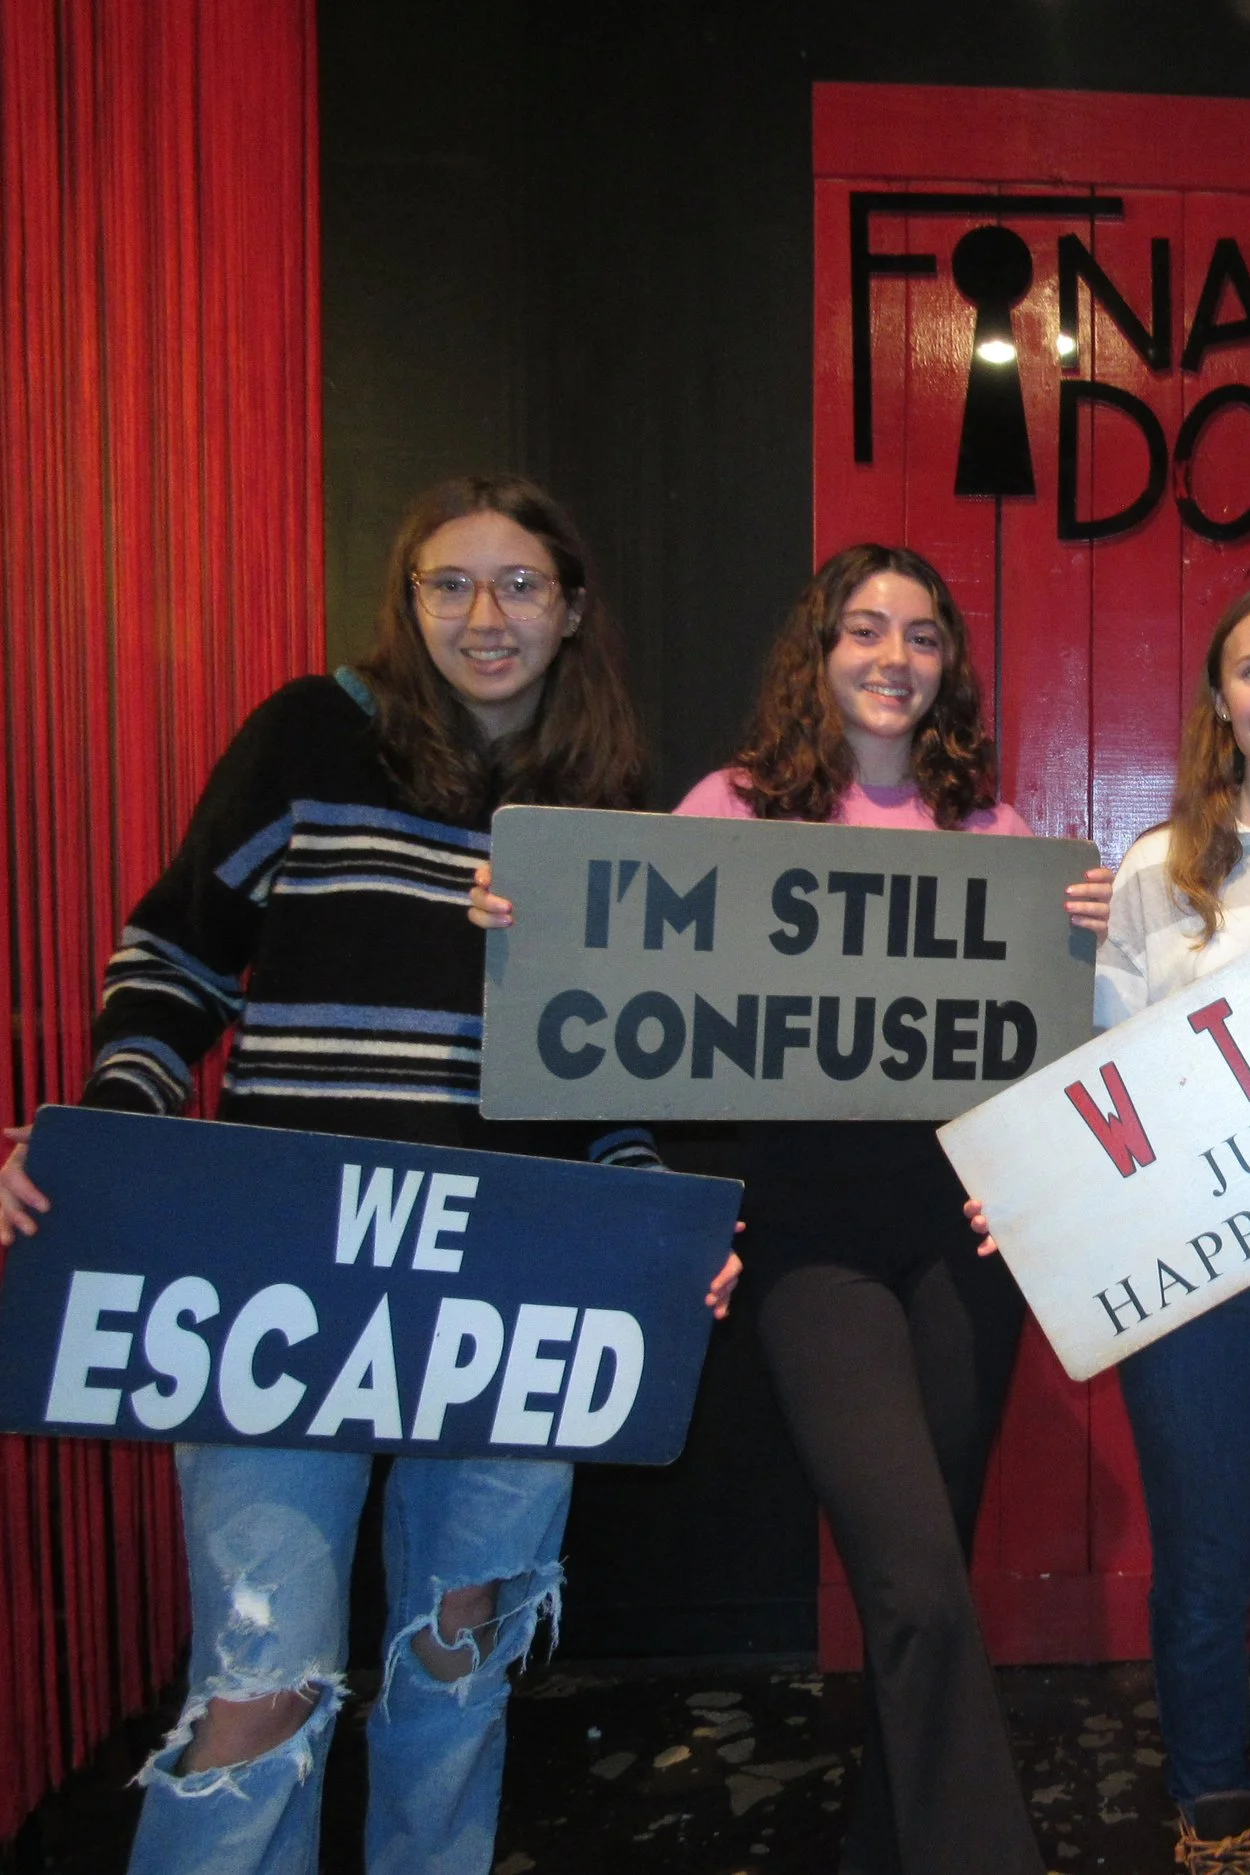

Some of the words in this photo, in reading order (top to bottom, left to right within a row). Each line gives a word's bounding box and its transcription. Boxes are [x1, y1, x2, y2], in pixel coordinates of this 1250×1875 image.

[584, 859, 718, 952] I'M
[768, 868, 1008, 961] STILL
[536, 988, 1038, 1082] CONFUSED
[334, 1163, 480, 1273] WE
[44, 1269, 646, 1449] ESCAPED
